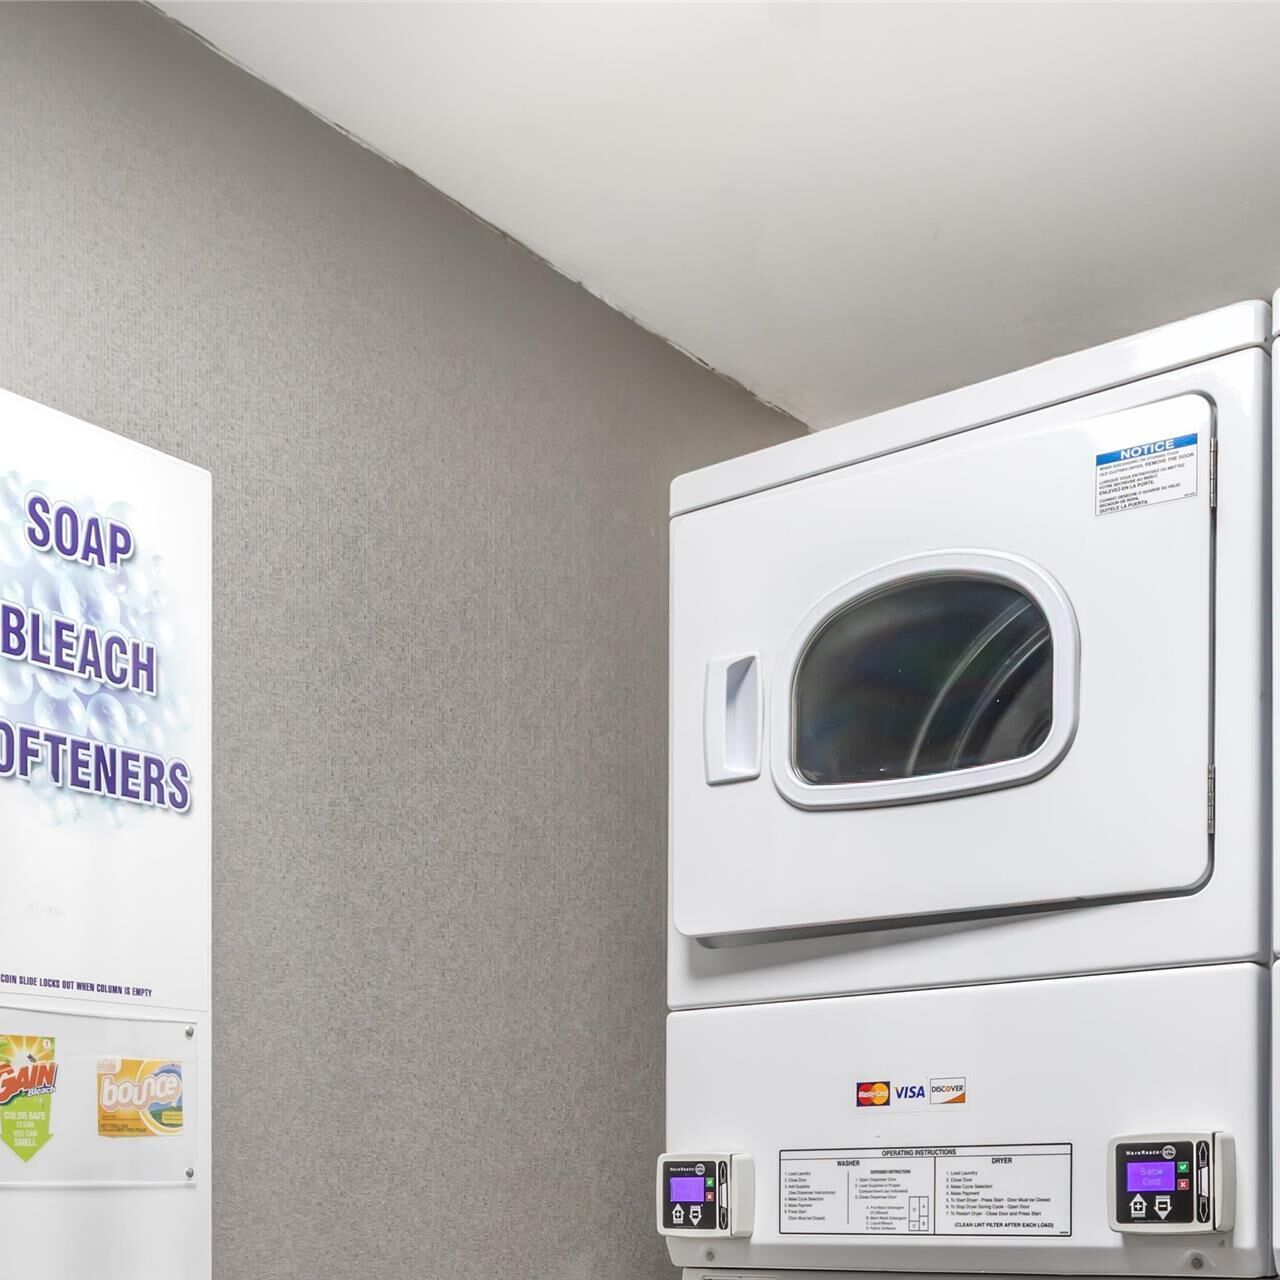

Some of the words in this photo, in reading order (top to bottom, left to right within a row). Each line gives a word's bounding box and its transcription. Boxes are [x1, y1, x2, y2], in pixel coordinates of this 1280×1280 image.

[1120, 440, 1175, 460] NOTICE
[26, 495, 133, 567] SOAP
[1, 603, 155, 694] BLEACH
[0, 973, 17, 984] COIN
[19, 975, 37, 986] SLIDE
[39, 977, 60, 989] LOCKS
[62, 980, 74, 990] OUT
[76, 981, 95, 992] WHEN
[96, 983, 123, 995] COLUMN
[124, 986, 131, 996] IS
[132, 987, 153, 998] EMPTY
[102, 1075, 179, 1107] bounce
[895, 1086, 925, 1099] VISA
[931, 1085, 964, 1093] DISCOVER
[915, 1148, 957, 1156] INSTRUCTIONS
